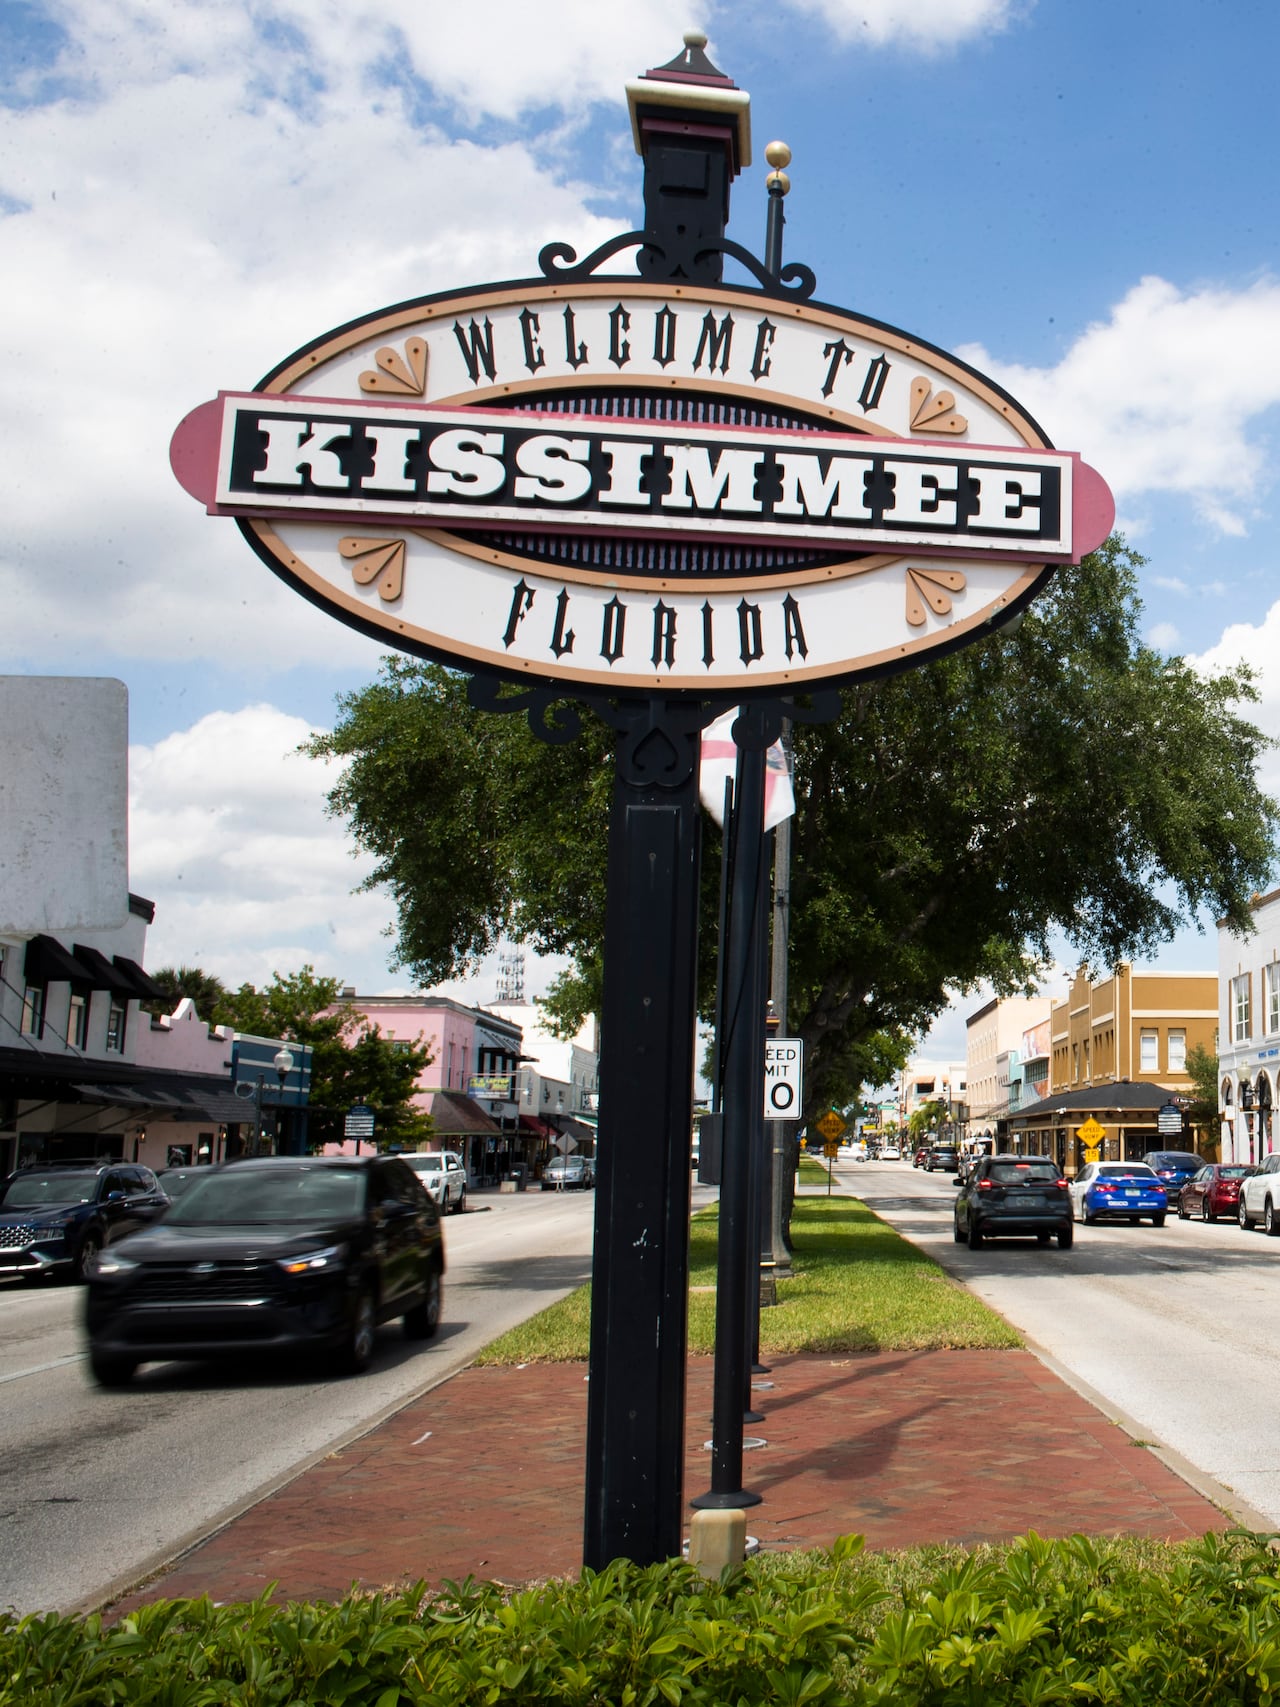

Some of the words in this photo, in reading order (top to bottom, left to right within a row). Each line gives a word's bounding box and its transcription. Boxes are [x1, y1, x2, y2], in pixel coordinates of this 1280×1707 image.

[453, 302, 779, 386] WELCOME
[822, 337, 894, 414] TO
[252, 418, 1043, 534] KISSIMMEE
[502, 576, 809, 670] FLORIDA
[765, 1065, 789, 1076] MIT
[766, 1049, 796, 1060] EED
[770, 1082, 794, 1110] 0
